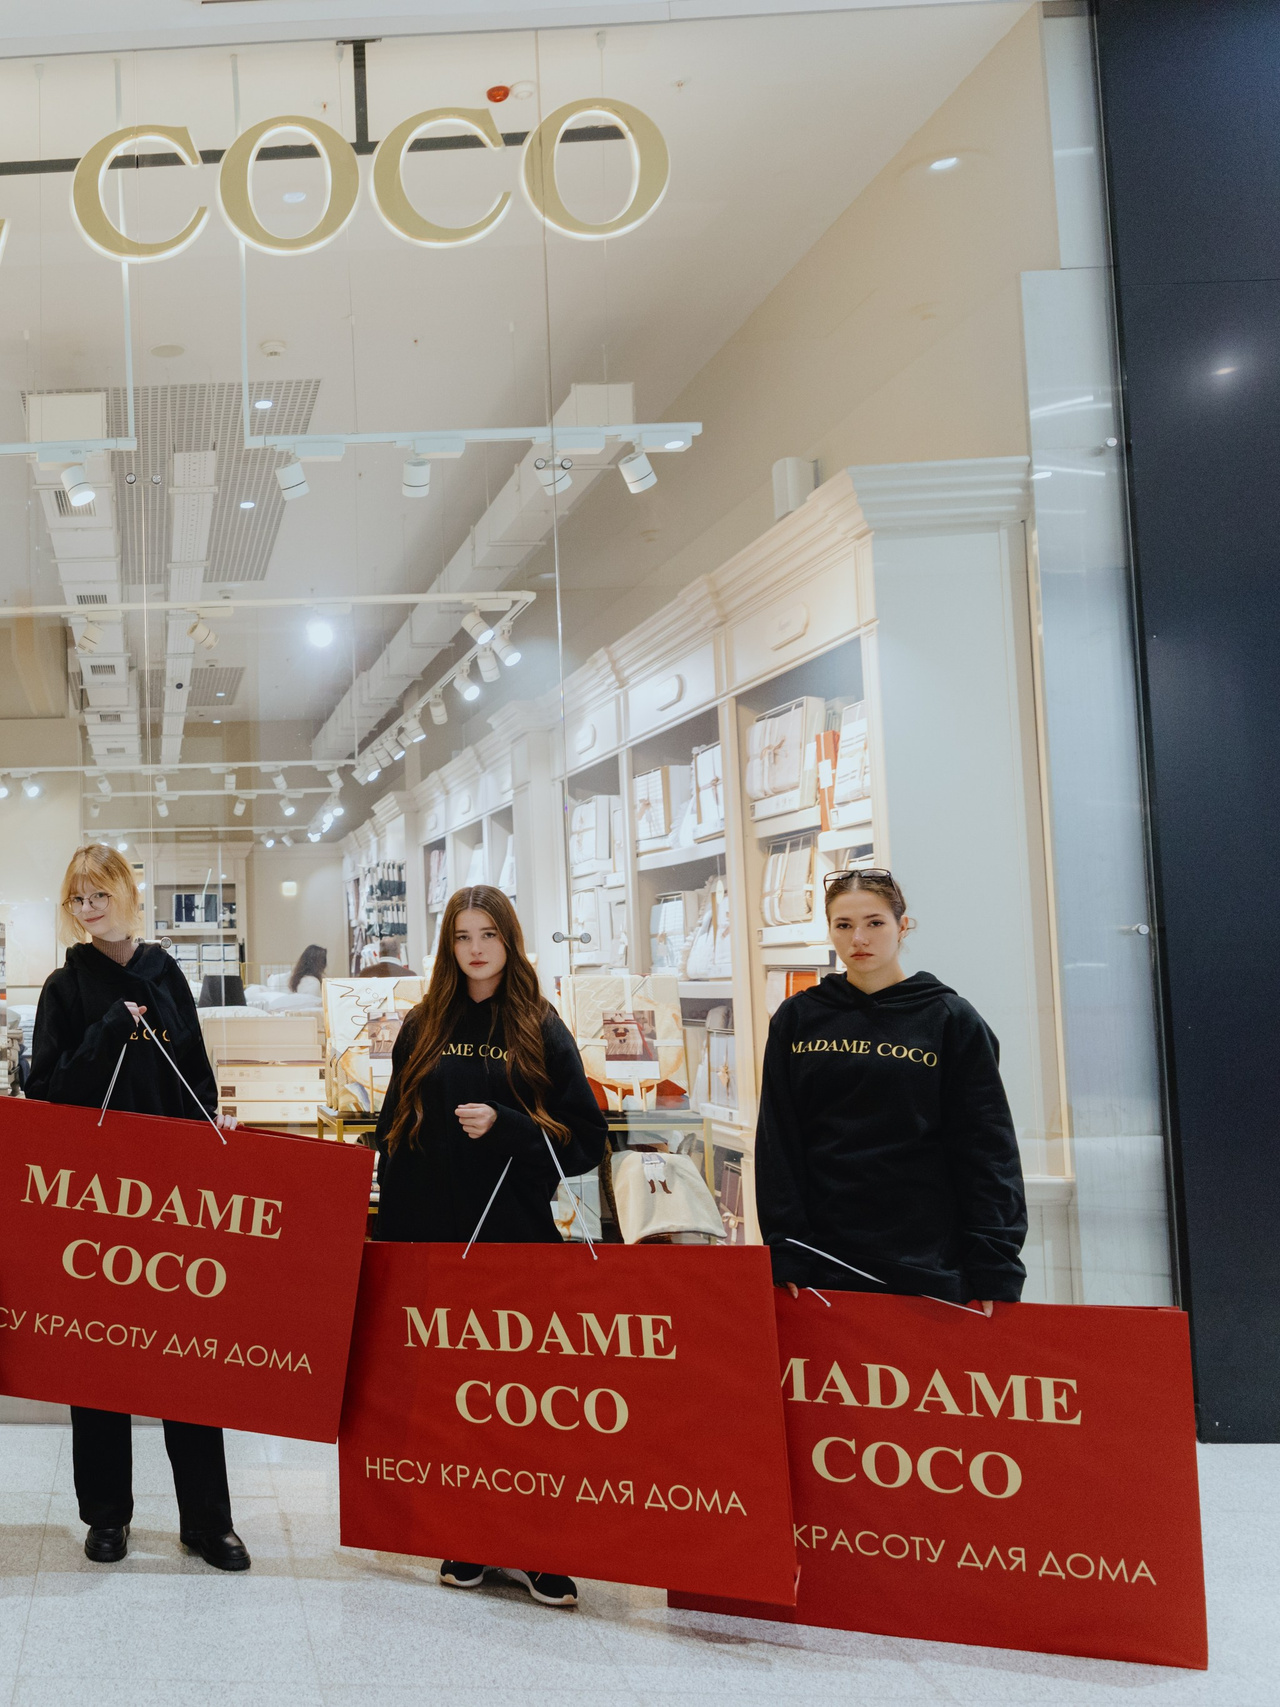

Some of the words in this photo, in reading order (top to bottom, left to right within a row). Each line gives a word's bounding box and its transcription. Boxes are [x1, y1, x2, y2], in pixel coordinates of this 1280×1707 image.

[72, 97, 670, 264] COCO
[478, 1042, 509, 1062] COC
[790, 1038, 872, 1055] MADAME
[875, 1042, 939, 1068] COCO
[21, 1164, 282, 1240] MADAME
[62, 1241, 226, 1297] COCO
[35, 1313, 157, 1349] КРАСОТУ
[163, 1334, 217, 1359] ДЛЯ
[224, 1343, 311, 1374] ДОМА
[402, 1307, 676, 1359] MADAME
[456, 1380, 628, 1433] COCO
[366, 1457, 431, 1484] НЕСУ
[441, 1464, 565, 1497] КРАСОТУ
[576, 1477, 634, 1505] ДЛЯ
[645, 1484, 747, 1516] ДОМА
[812, 1437, 1022, 1498] COCO
[794, 1524, 945, 1562] КРАСОТУ
[957, 1543, 1026, 1572] ДЛЯ
[1039, 1551, 1156, 1585] ДОМА
